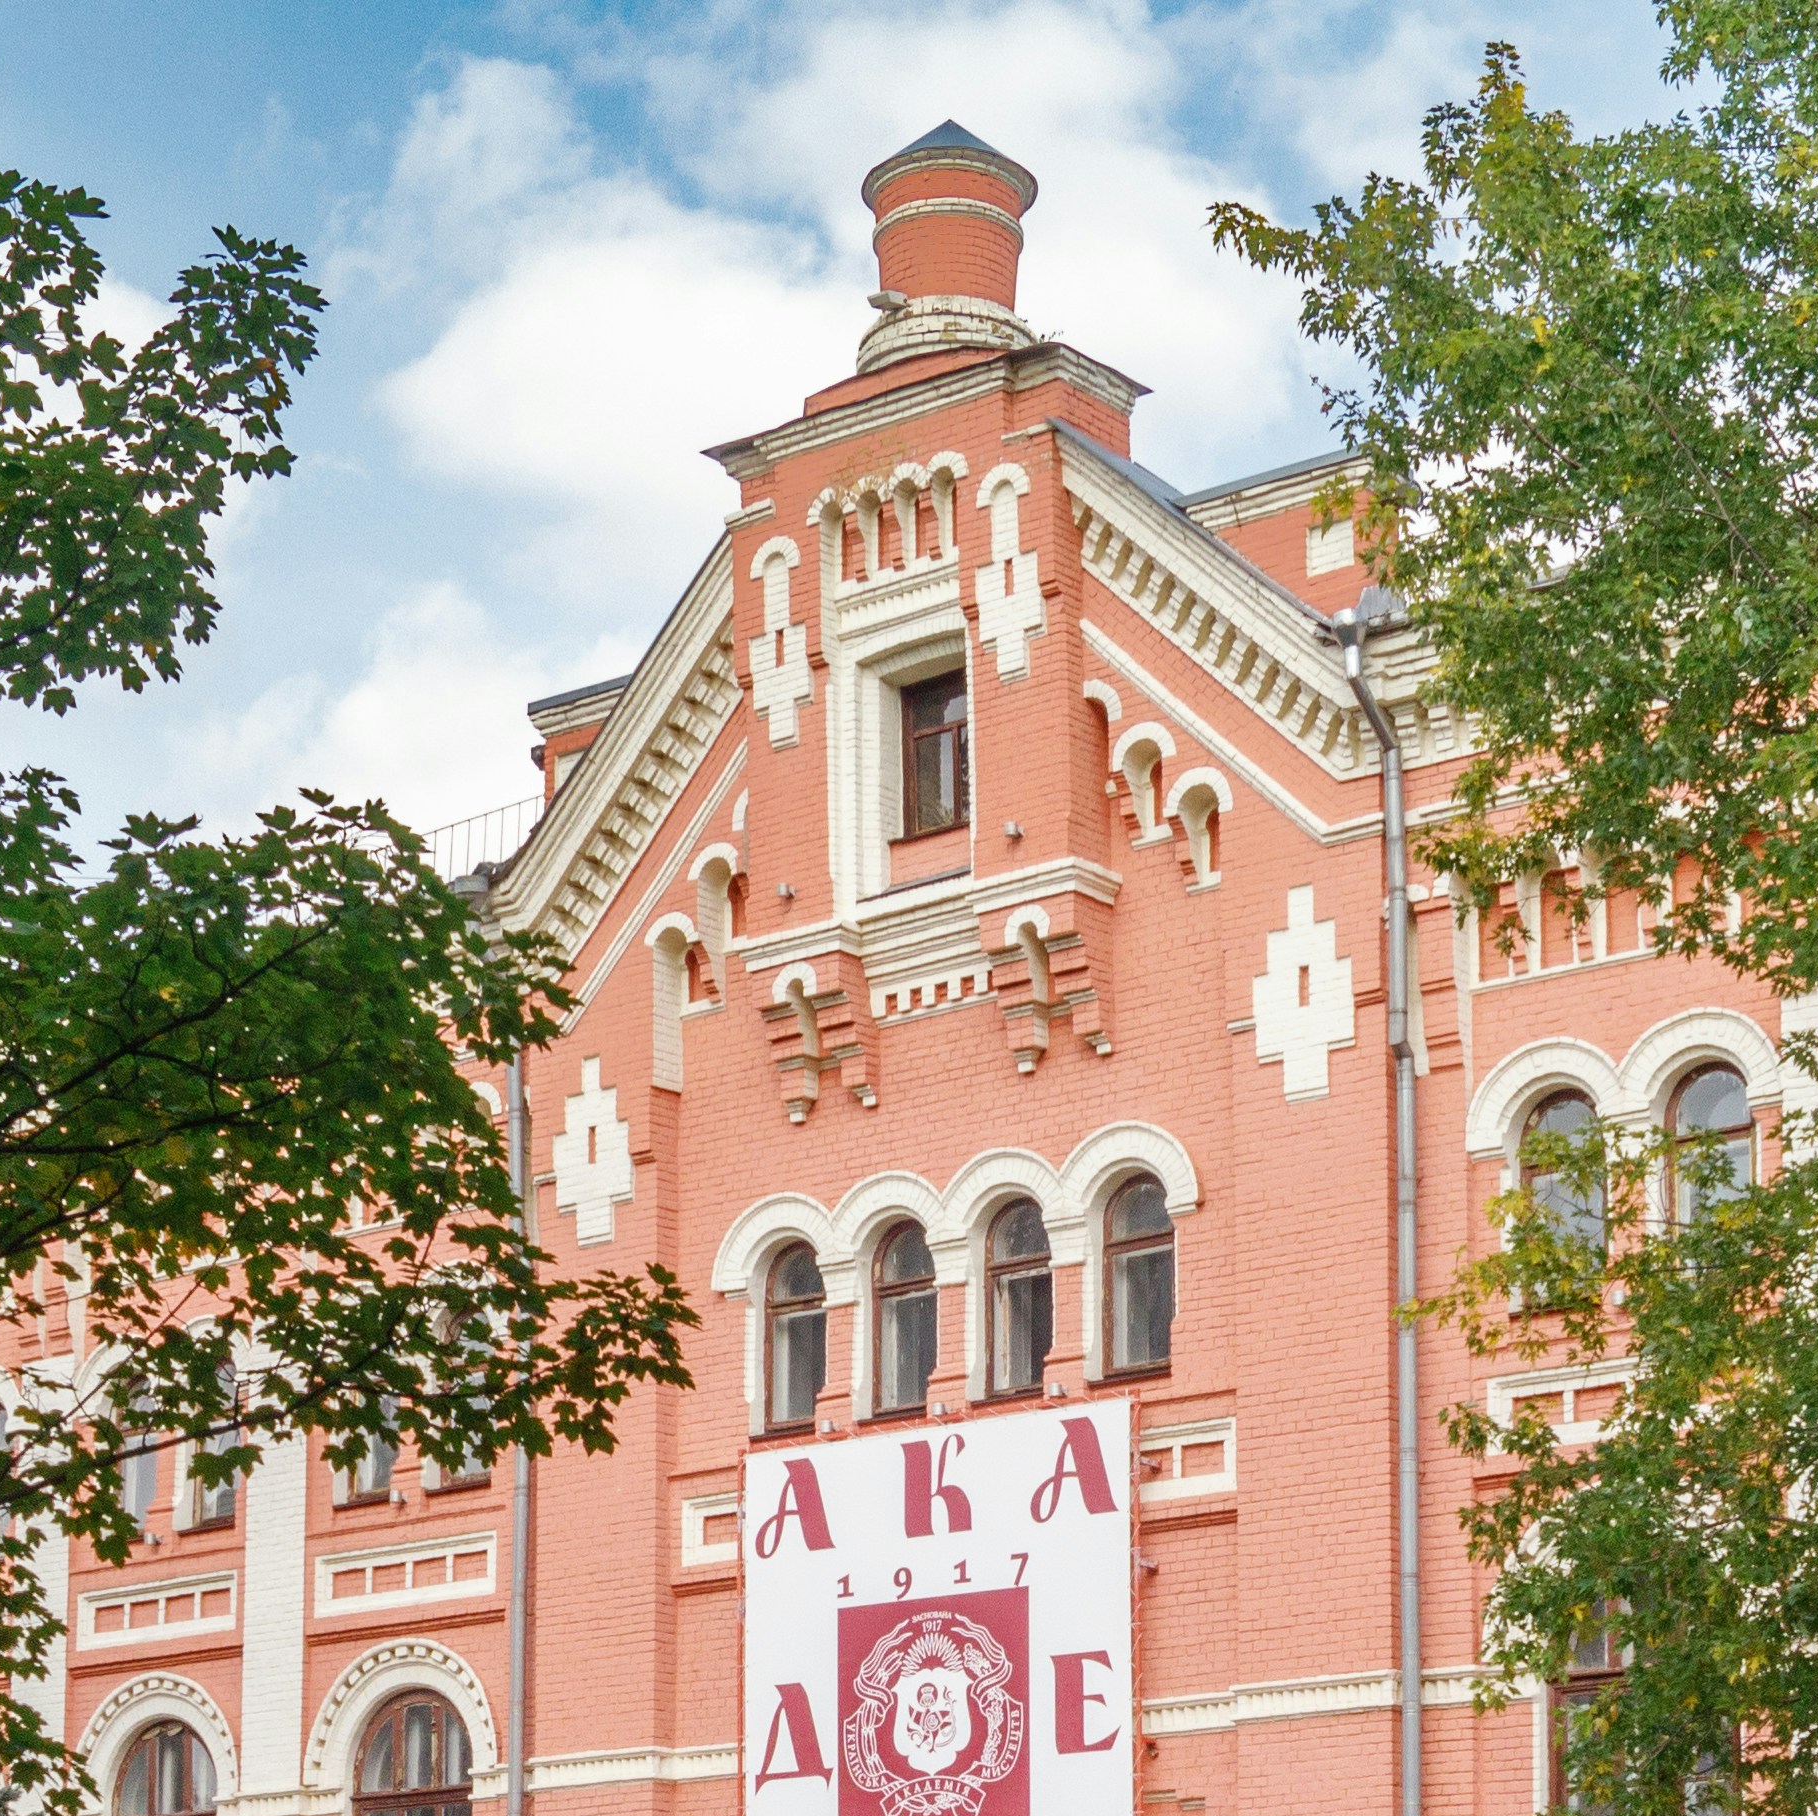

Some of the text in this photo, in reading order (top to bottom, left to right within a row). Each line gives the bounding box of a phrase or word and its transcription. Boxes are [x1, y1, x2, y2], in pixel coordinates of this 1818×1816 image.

[836, 1552, 1029, 1600] 1917
[922, 1619, 942, 1632] 1917
[894, 1779, 971, 1804] АКАДЕМІЯ
[980, 1709, 1021, 1778] МИСТЕЦТВ
